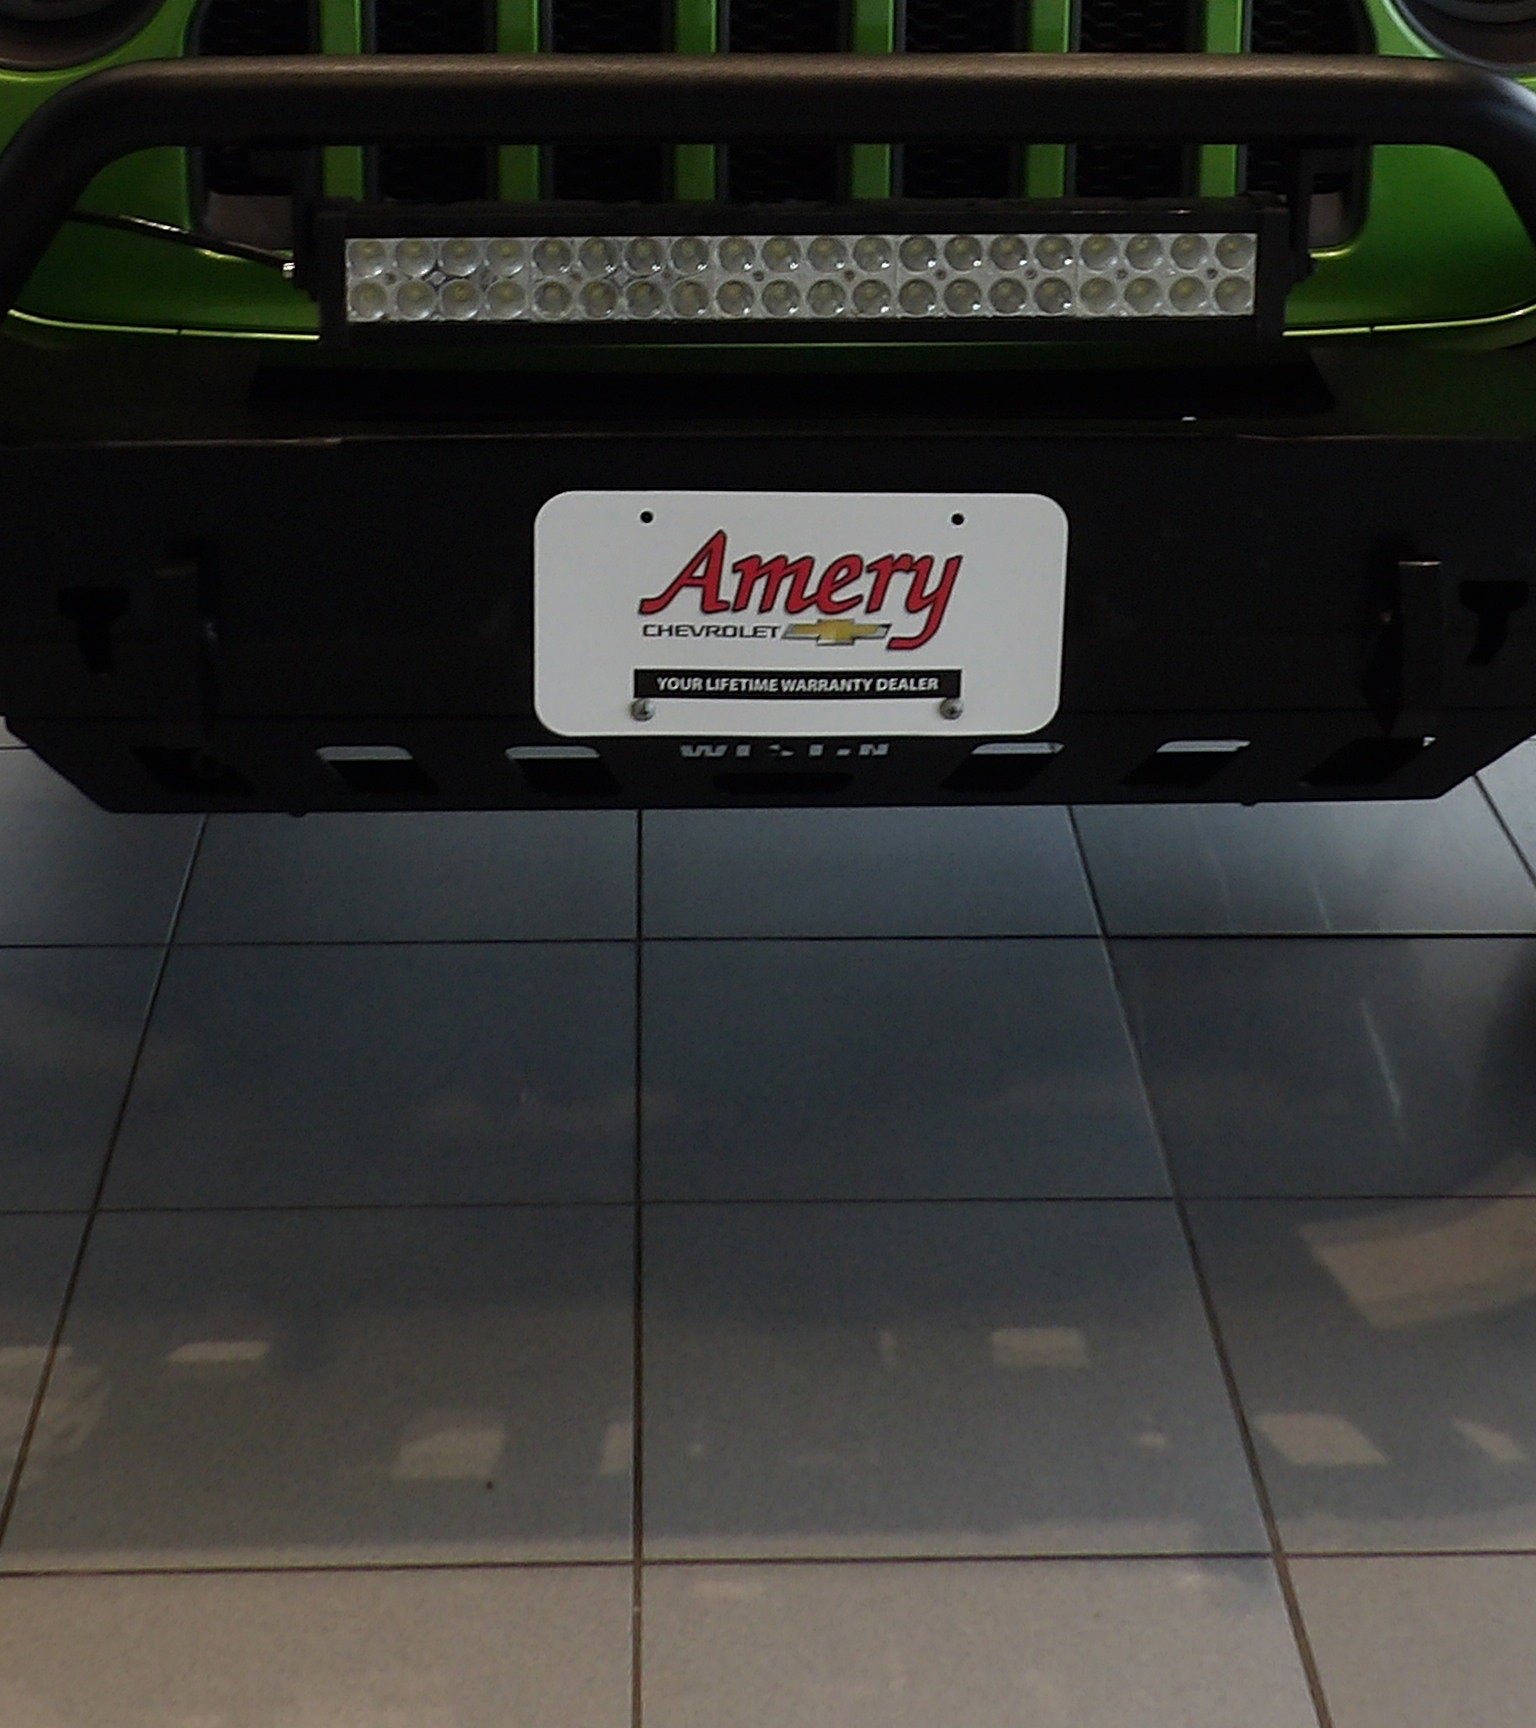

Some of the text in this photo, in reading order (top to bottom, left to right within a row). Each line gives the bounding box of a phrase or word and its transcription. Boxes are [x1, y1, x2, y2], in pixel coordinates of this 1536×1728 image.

[638, 529, 963, 650] Amery
[642, 624, 781, 639] CHEVROLET
[656, 676, 939, 693] YOUR LIFETIME WARRANTY DEALER
